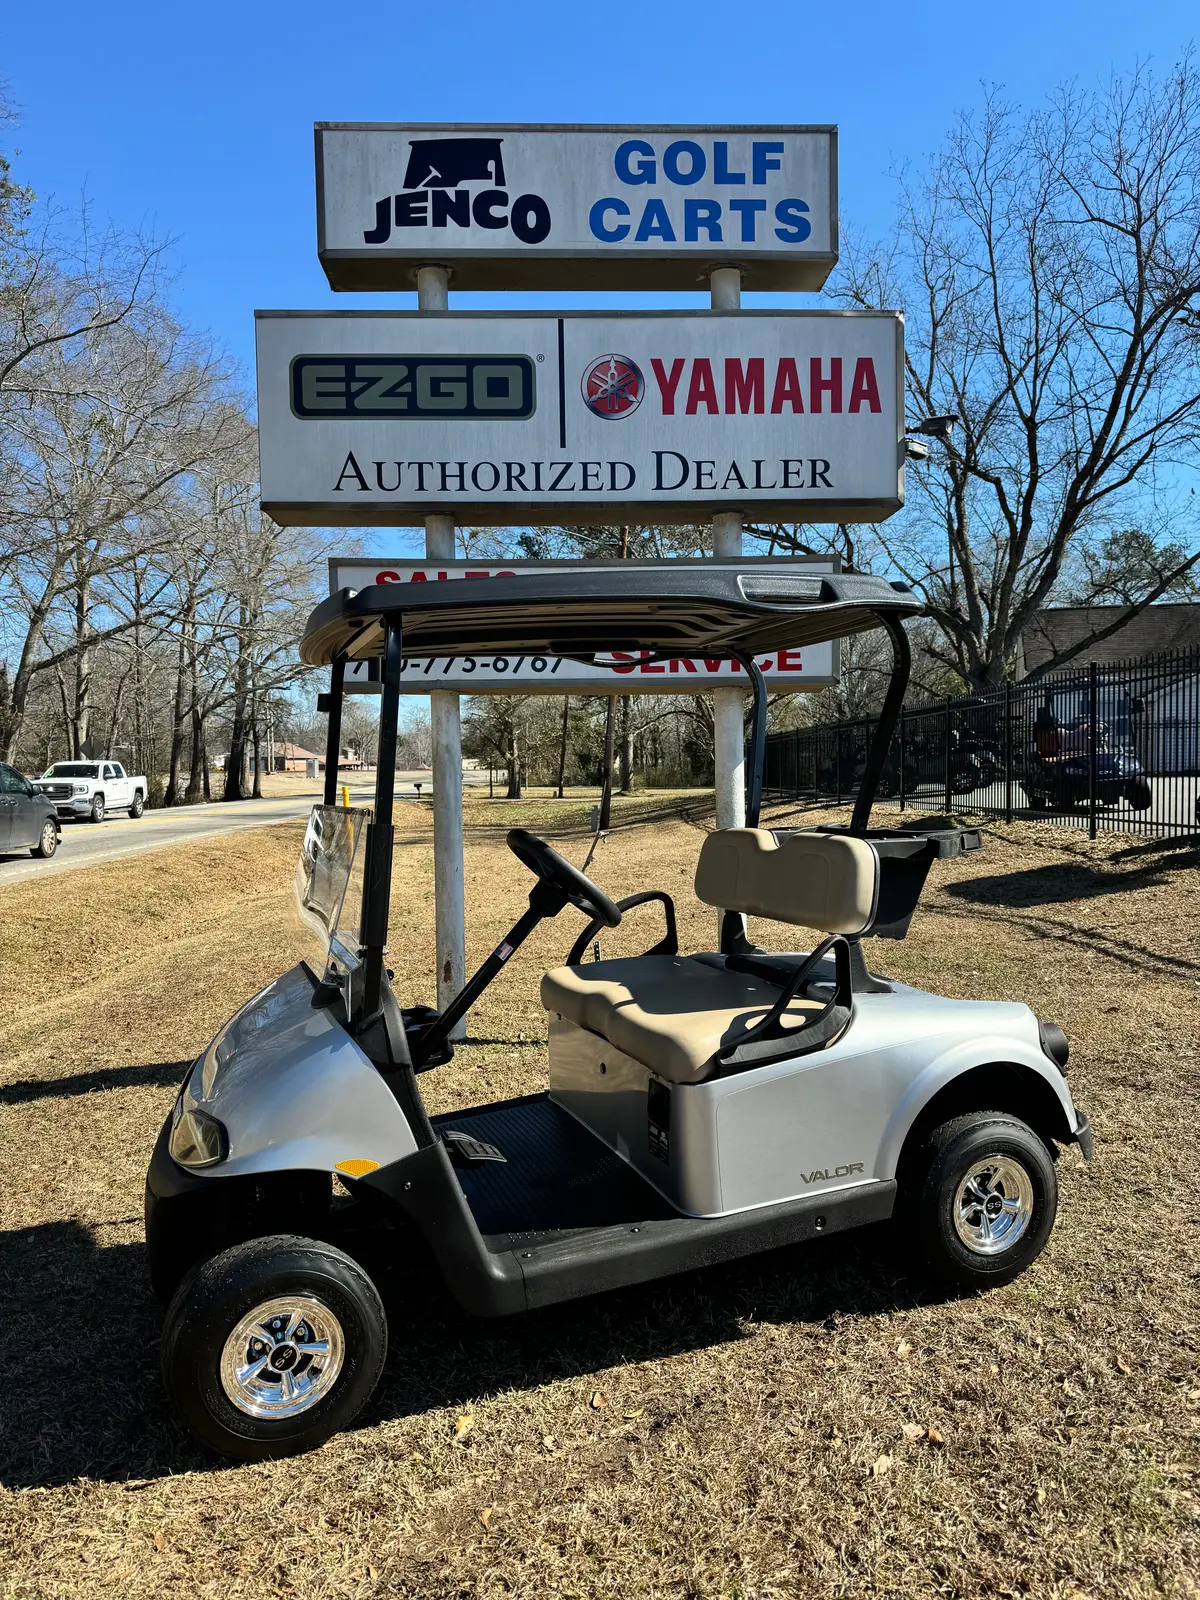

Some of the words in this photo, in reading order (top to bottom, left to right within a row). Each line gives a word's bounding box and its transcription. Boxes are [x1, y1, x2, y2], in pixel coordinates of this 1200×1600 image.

[613, 139, 785, 187] GOLF
[363, 189, 552, 245] JENCO
[588, 197, 812, 244] CARTS
[301, 364, 523, 410] EZGO
[649, 357, 882, 415] YAMAHA
[331, 450, 637, 492] AUTHORIZED
[650, 450, 835, 491] DEALER
[800, 1160, 865, 1184] VALOR
[275, 1348, 293, 1369] SS
